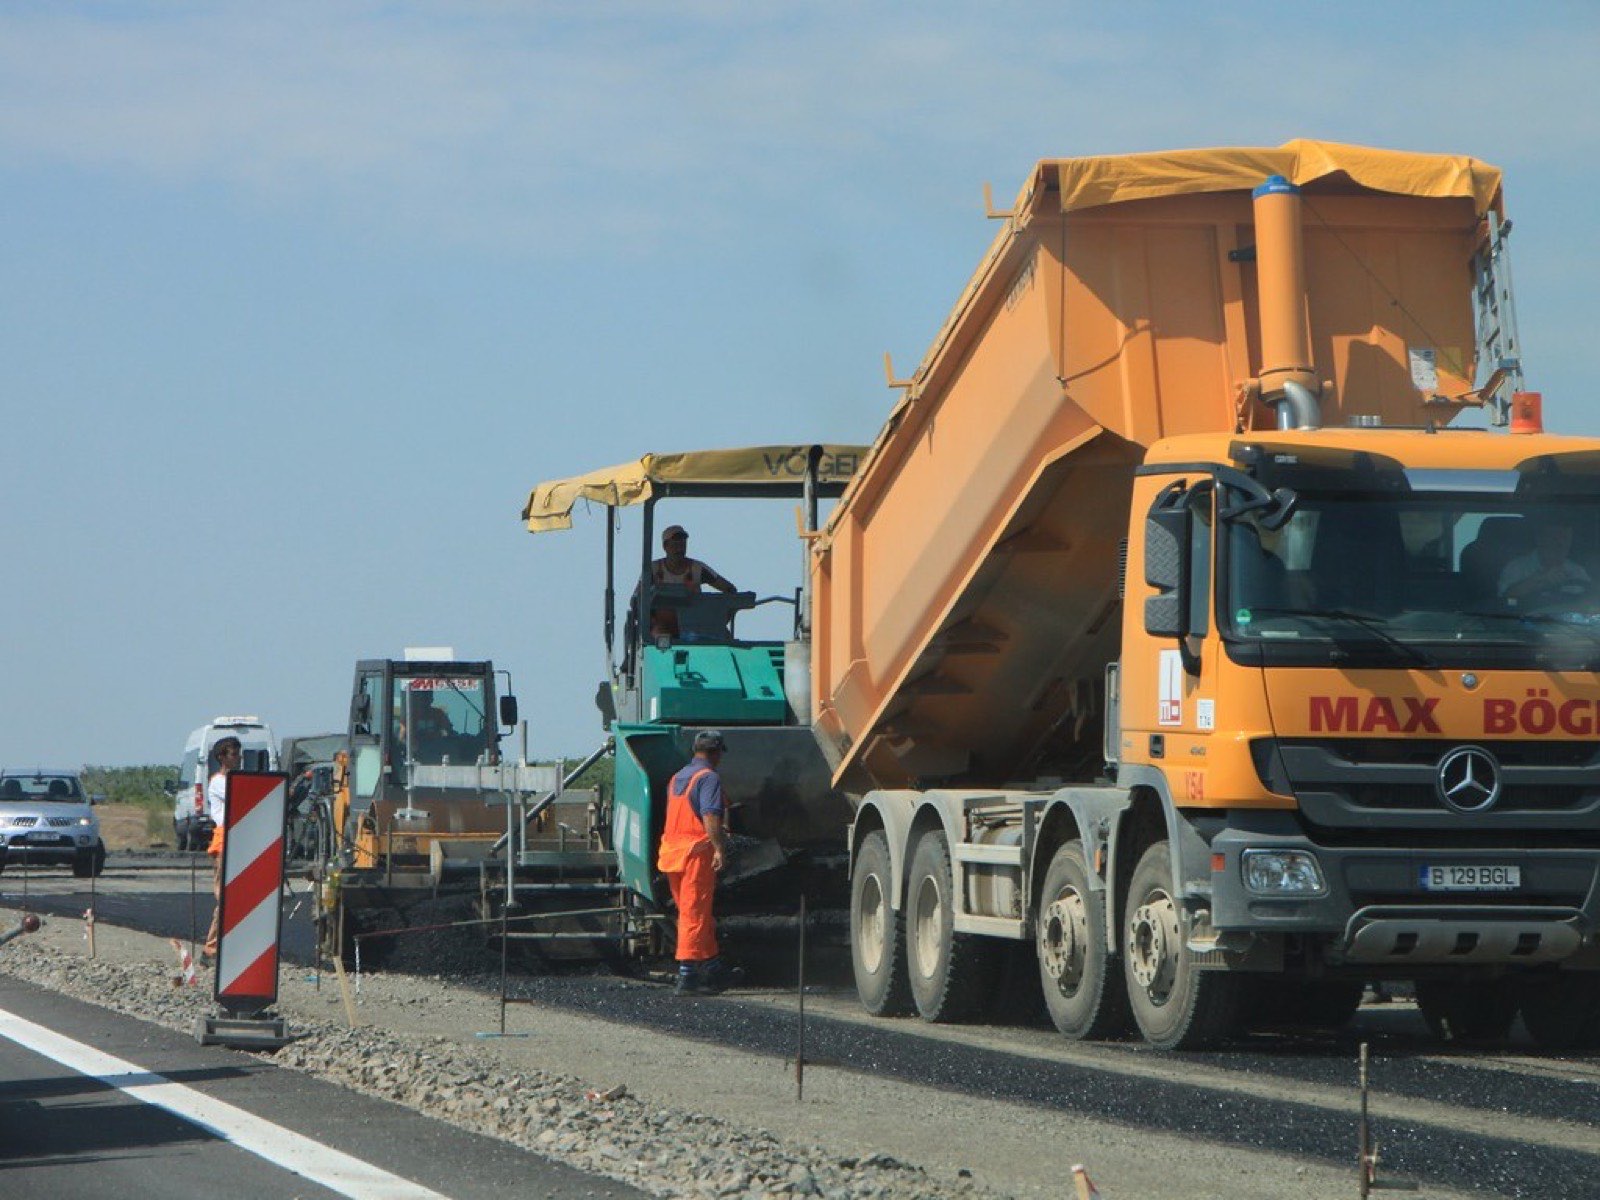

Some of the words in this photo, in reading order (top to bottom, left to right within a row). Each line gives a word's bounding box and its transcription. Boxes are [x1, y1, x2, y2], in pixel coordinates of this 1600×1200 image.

[1309, 696, 1443, 734] MAX
[1483, 688, 1600, 735] BÖG
[1432, 867, 1445, 885] B
[1449, 867, 1476, 885] 129
[1479, 867, 1515, 885] BGL
